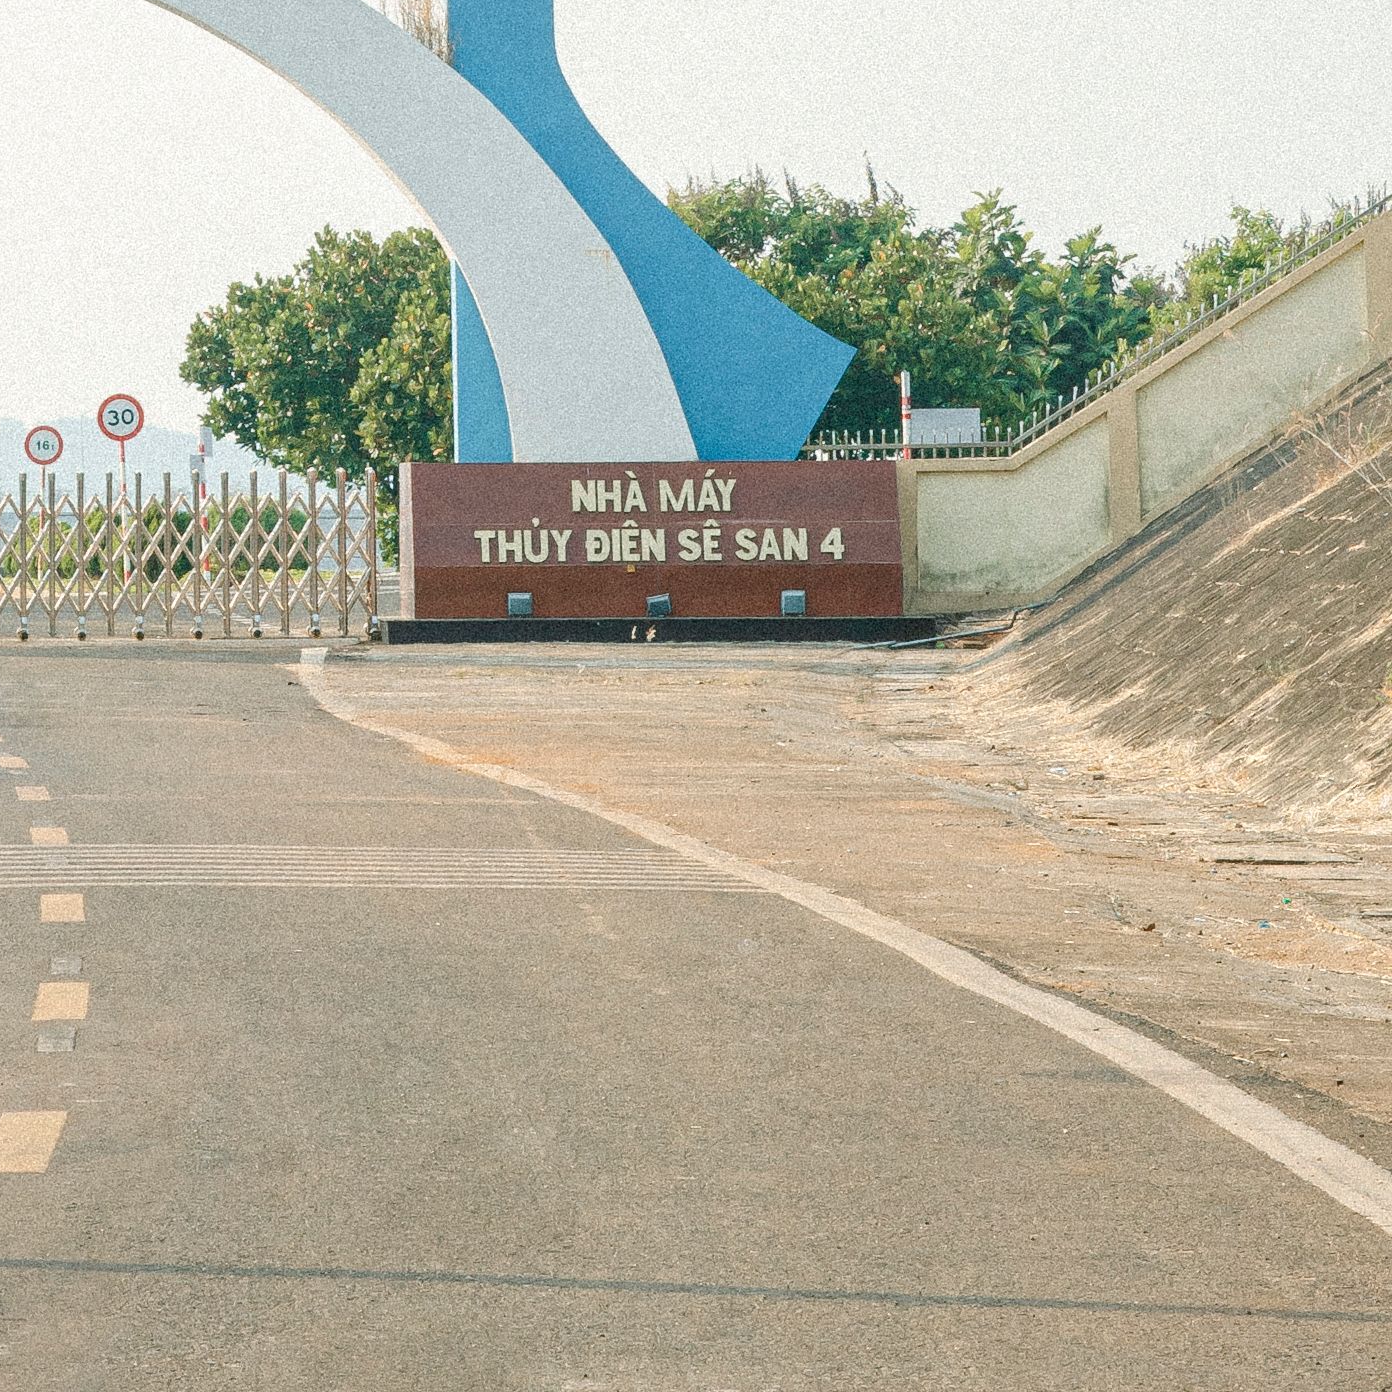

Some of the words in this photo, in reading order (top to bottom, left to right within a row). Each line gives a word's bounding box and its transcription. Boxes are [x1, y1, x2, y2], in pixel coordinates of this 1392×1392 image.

[108, 408, 135, 426] 30
[571, 470, 648, 513] NHÀ
[658, 468, 737, 512] MÁY
[473, 517, 573, 563] THỦY
[677, 518, 723, 562] SÊ
[734, 527, 808, 561] SAN
[820, 527, 846, 560] 4
